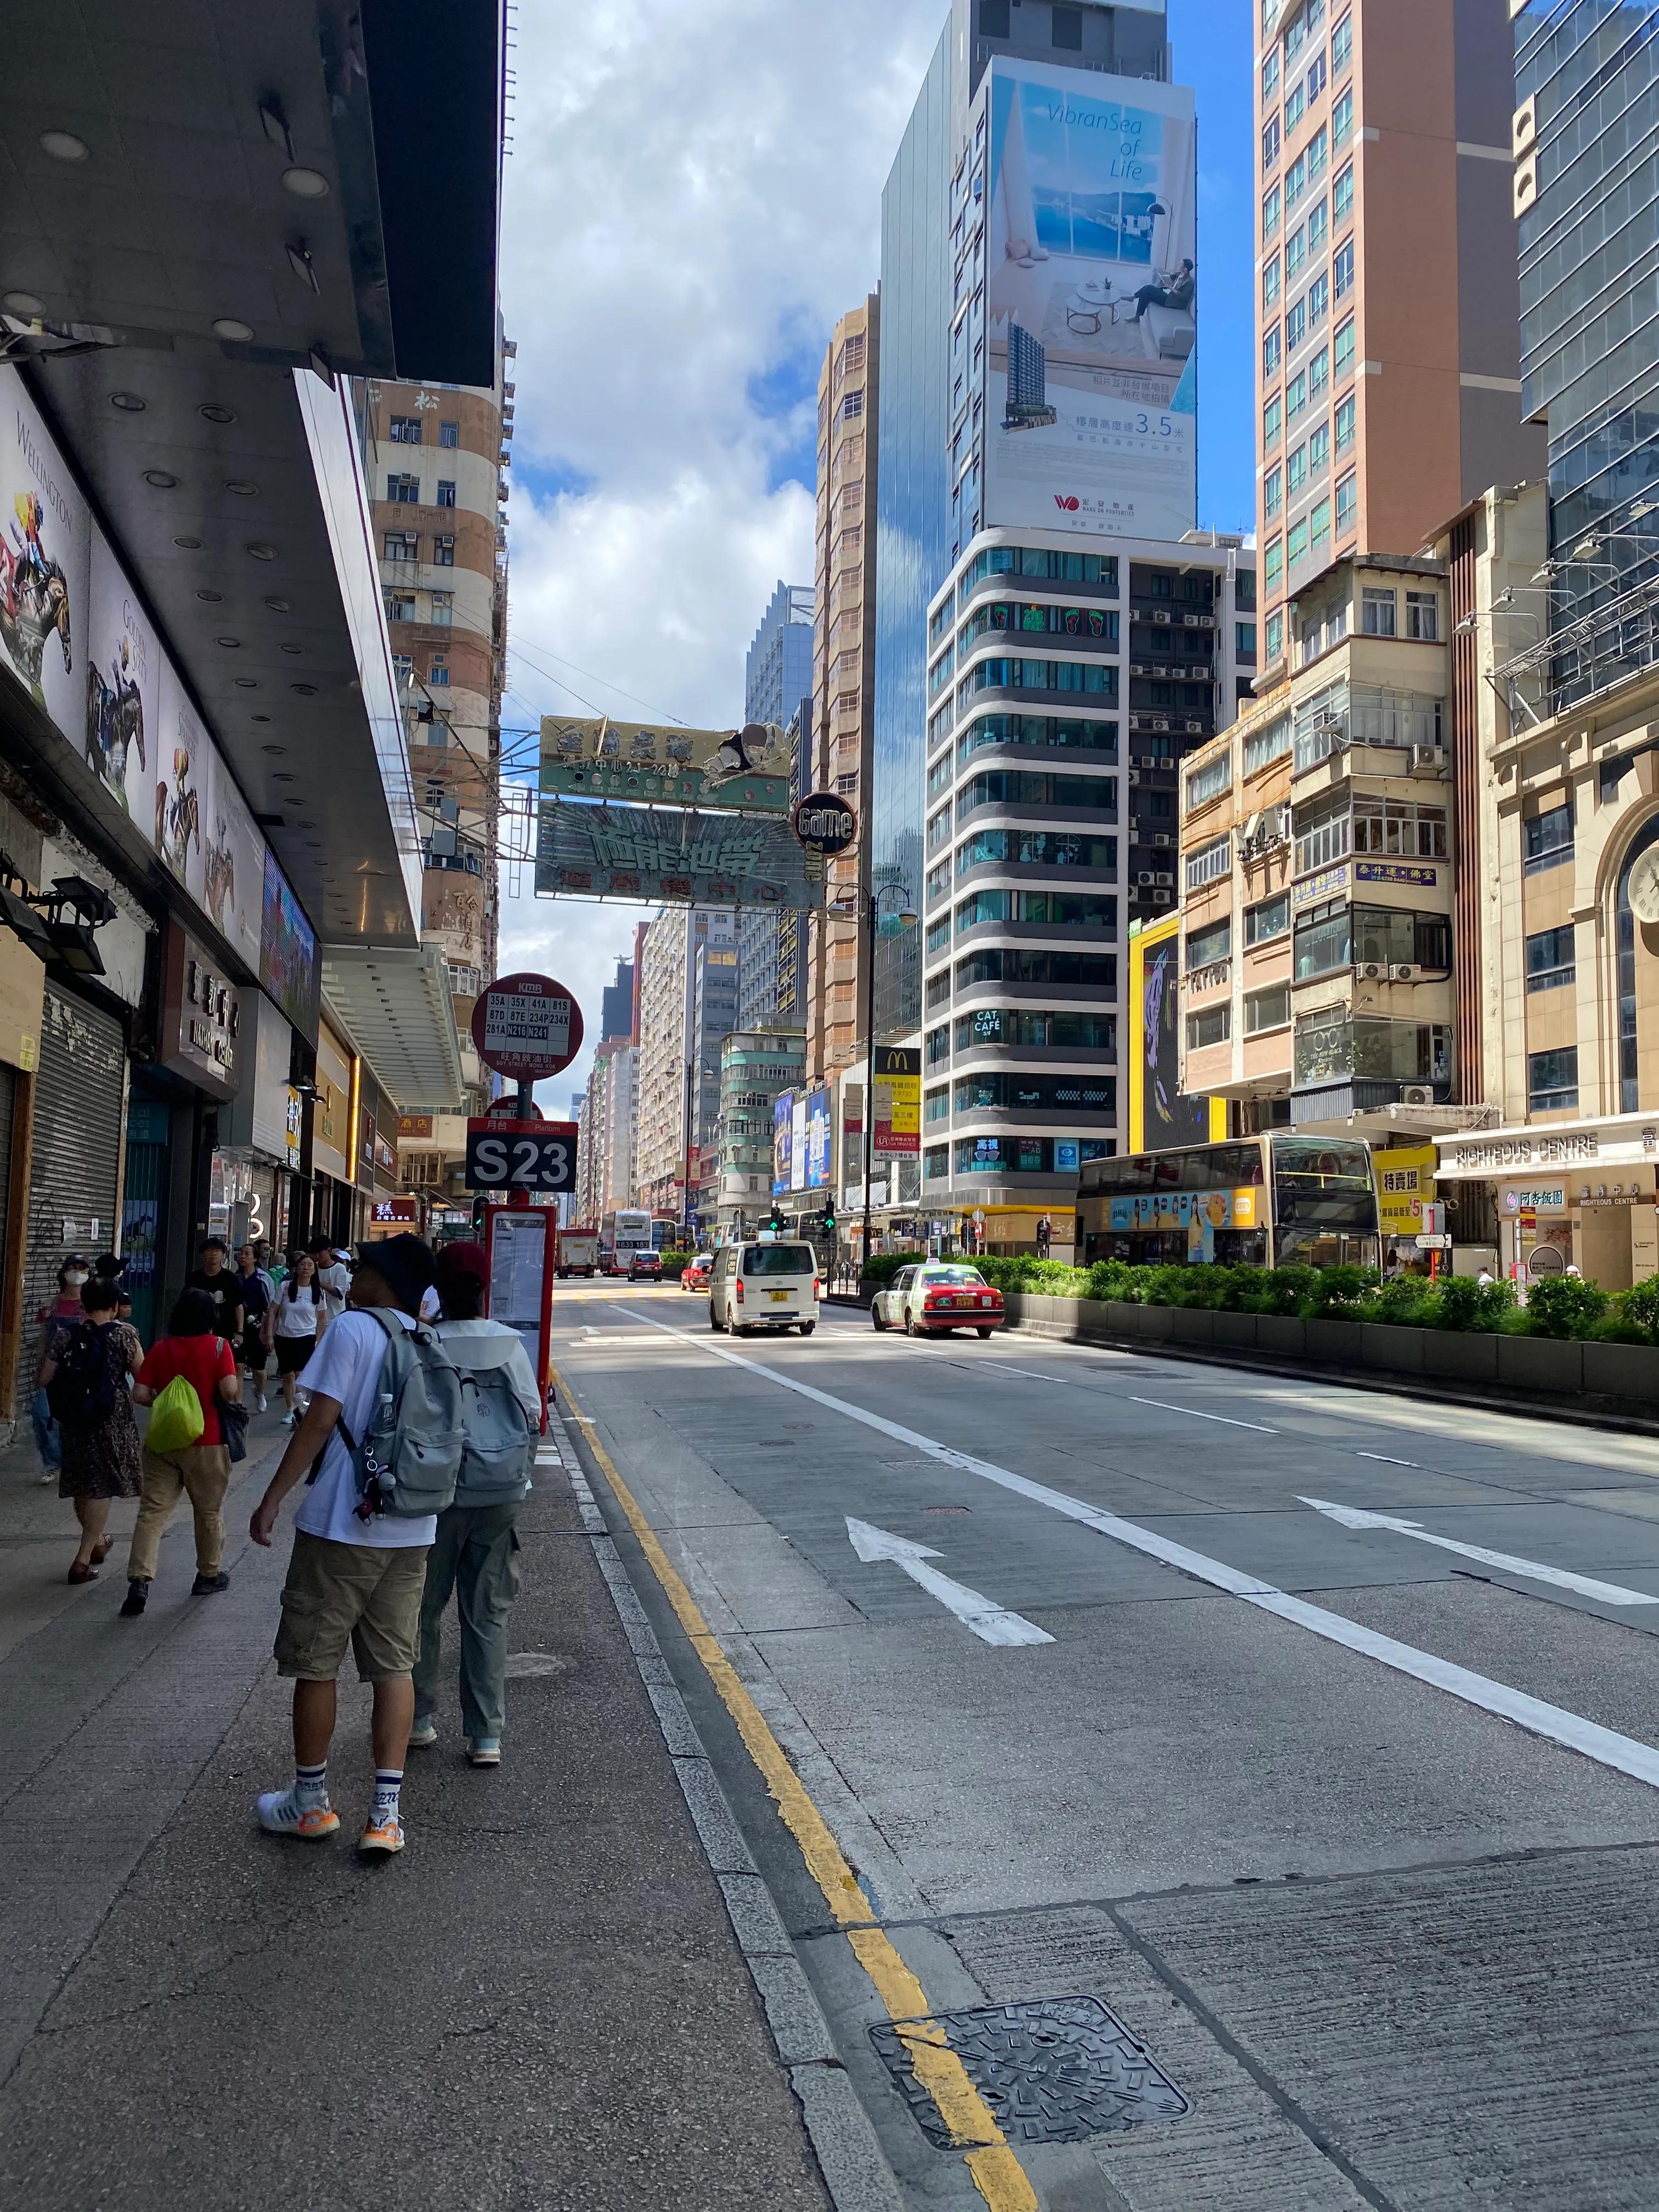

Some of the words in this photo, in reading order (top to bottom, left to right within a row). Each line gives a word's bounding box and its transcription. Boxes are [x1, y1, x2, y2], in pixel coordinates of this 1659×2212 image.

[1047, 103, 1142, 135] VibranSea
[1120, 139, 1141, 156] of
[1110, 160, 1142, 181] Life
[1092, 376, 1170, 393] 相片並非發展項目
[1121, 391, 1170, 404] 所在地拍攝
[16, 410, 72, 532] WELLINGTON
[1105, 509, 1135, 517] PROPERTIES
[123, 599, 146, 659] GOLDEN
[518, 983, 543, 994] KMB
[490, 995, 505, 1006] 35A
[511, 997, 526, 1007] 35X
[532, 998, 546, 1009] 41A
[553, 1000, 567, 1011] 81S
[490, 1010, 505, 1020] 87D
[510, 1011, 525, 1022] 87E
[529, 1013, 549, 1023] 234P
[550, 1014, 568, 1025] 234X
[977, 1010, 997, 1020] CAT
[487, 1024, 505, 1034] 281A
[974, 1018, 1000, 1031] CAFÉ
[507, 1025, 526, 1036] N216
[529, 1026, 548, 1037] N241
[400, 1118, 427, 1128] 酒店
[487, 1120, 507, 1130] 月台
[535, 1124, 561, 1132] Platform
[1455, 1142, 1531, 1164] RIGHTEOUS
[1538, 1137, 1598, 1159] CENTRE
[474, 1139, 568, 1184] S23
[1384, 1171, 1418, 1192] 特賣場
[376, 1200, 393, 1215] 糕
[1580, 1198, 1612, 1206] RIGHTEOUS
